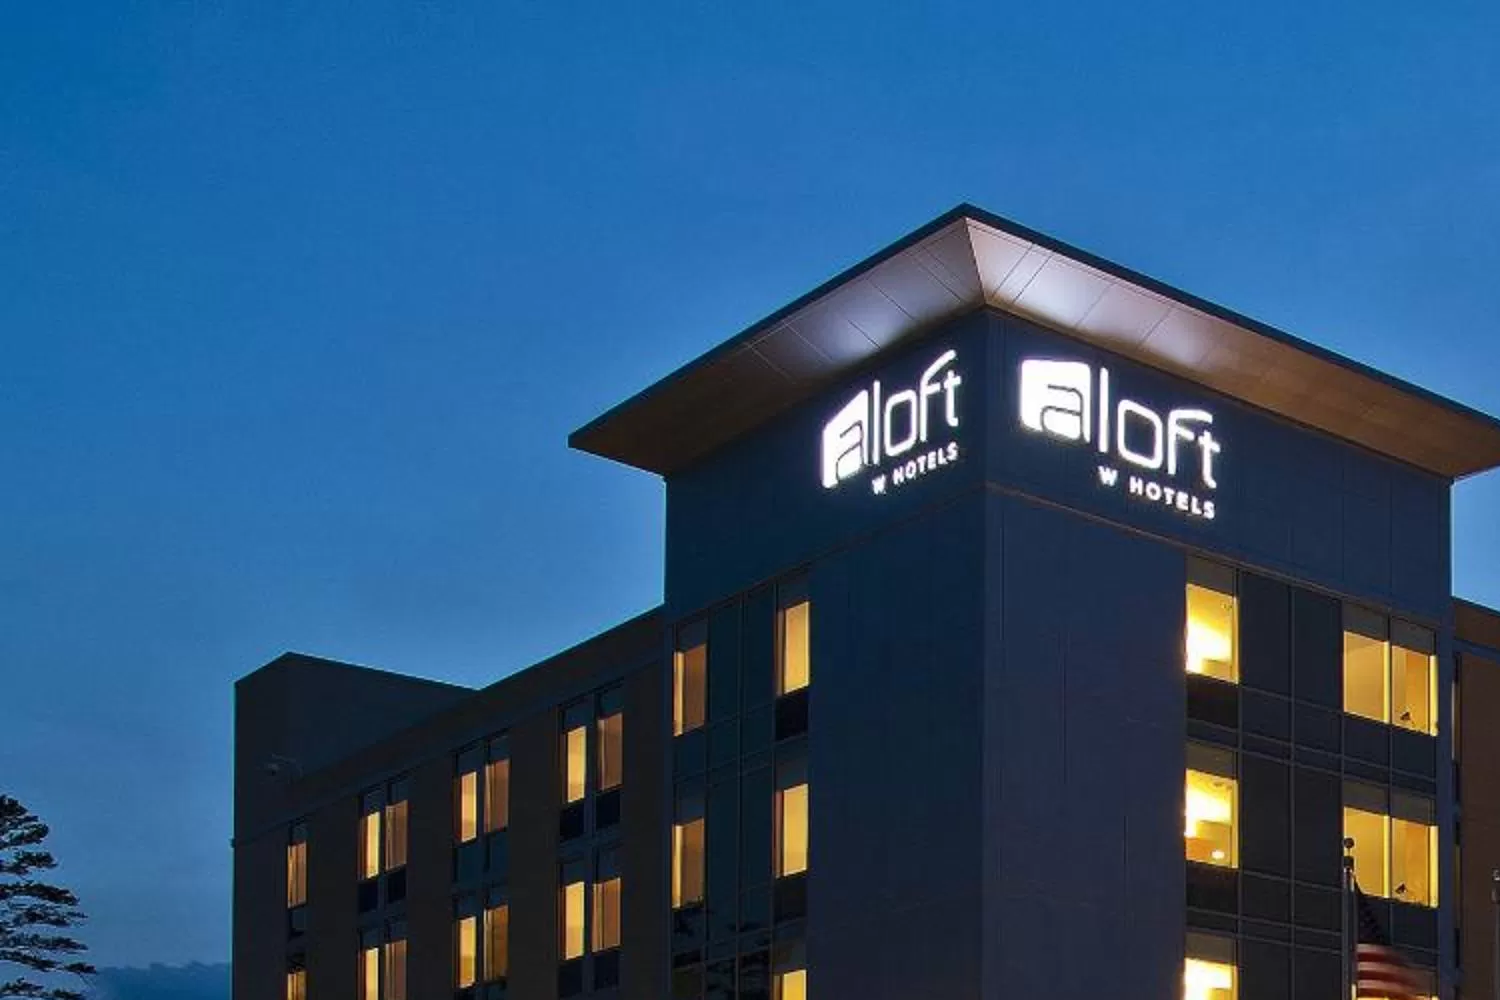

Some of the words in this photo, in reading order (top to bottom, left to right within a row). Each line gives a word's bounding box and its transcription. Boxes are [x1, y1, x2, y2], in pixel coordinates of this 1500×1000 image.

[821, 348, 962, 490] aloft
[1018, 358, 1221, 489] aloft
[871, 474, 887, 496] W
[892, 441, 959, 485] HOTELS
[1097, 465, 1118, 487] W
[1129, 476, 1216, 520] HOTELS
